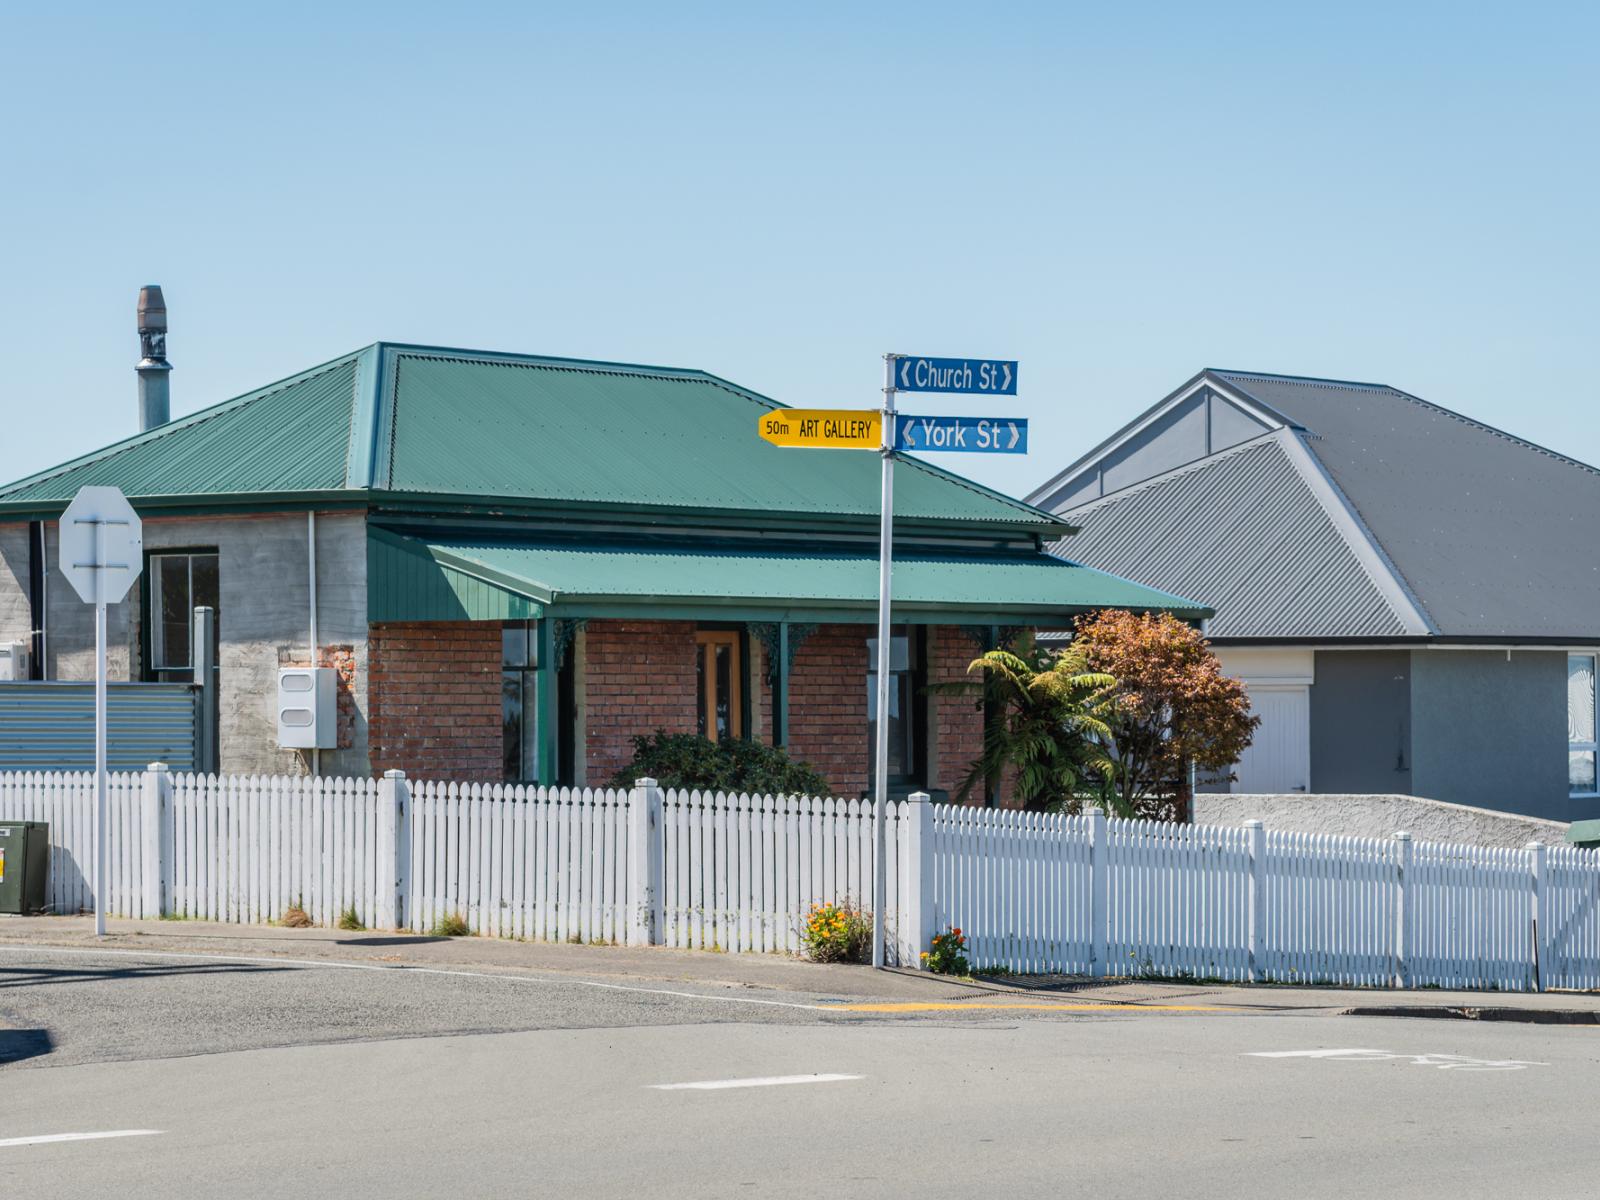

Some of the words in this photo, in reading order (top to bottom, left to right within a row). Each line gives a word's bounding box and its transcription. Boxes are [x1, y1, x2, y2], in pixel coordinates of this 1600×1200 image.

[914, 359, 972, 389] Church
[979, 362, 997, 390] St
[766, 421, 789, 435] 50m
[799, 419, 820, 438] ART
[824, 420, 872, 439] GALLERY
[921, 418, 966, 448] York
[976, 420, 1001, 449] St
